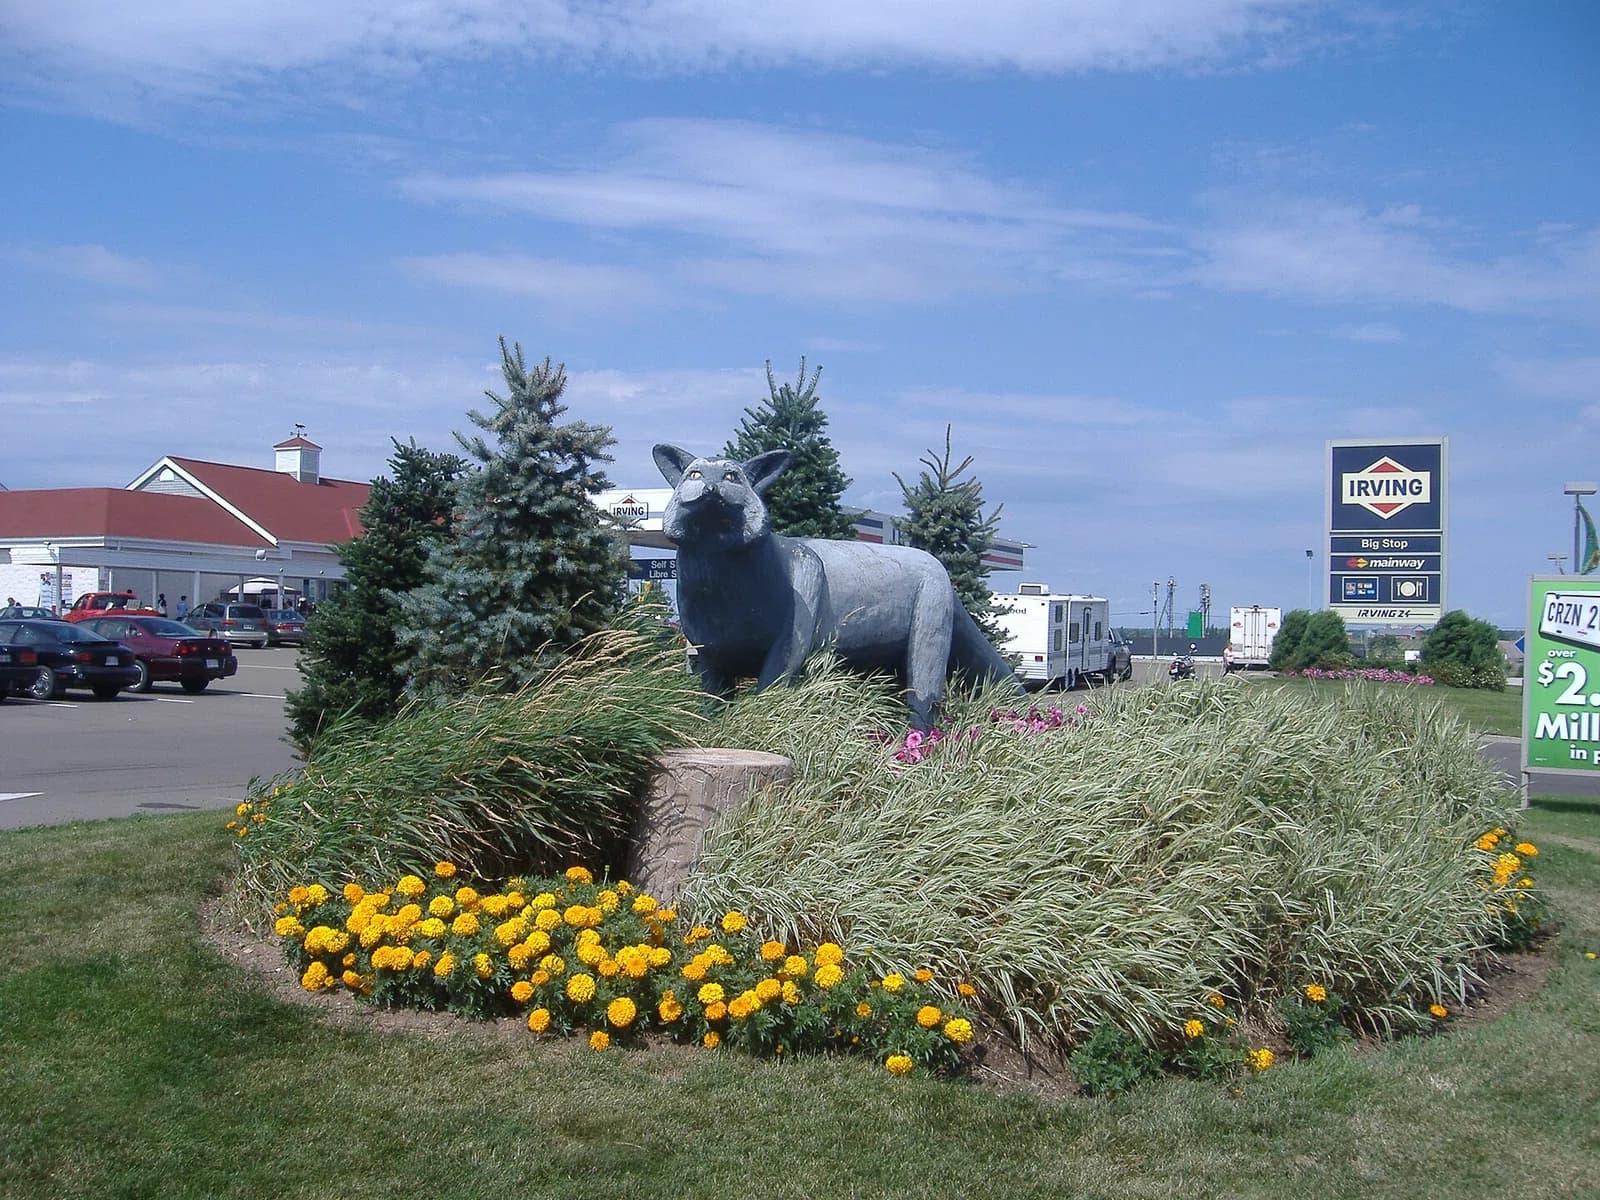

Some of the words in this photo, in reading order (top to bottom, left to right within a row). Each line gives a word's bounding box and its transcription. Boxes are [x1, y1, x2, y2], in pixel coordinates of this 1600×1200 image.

[1349, 478, 1423, 496] IRVING
[613, 506, 644, 516] IRVING
[1361, 539, 1380, 550] Big
[1382, 539, 1408, 549] Stop
[651, 560, 667, 569] Self
[669, 560, 676, 569] S
[1370, 558, 1425, 569] mainway
[649, 570, 669, 578] Libre
[671, 570, 677, 578] S
[1357, 609, 1398, 618] IRVING
[1547, 601, 1583, 626] CRZN
[1587, 605, 1600, 631] 2
[1547, 649, 1576, 658] over
[1534, 711, 1600, 742] Mill
[1570, 743, 1588, 760] in
